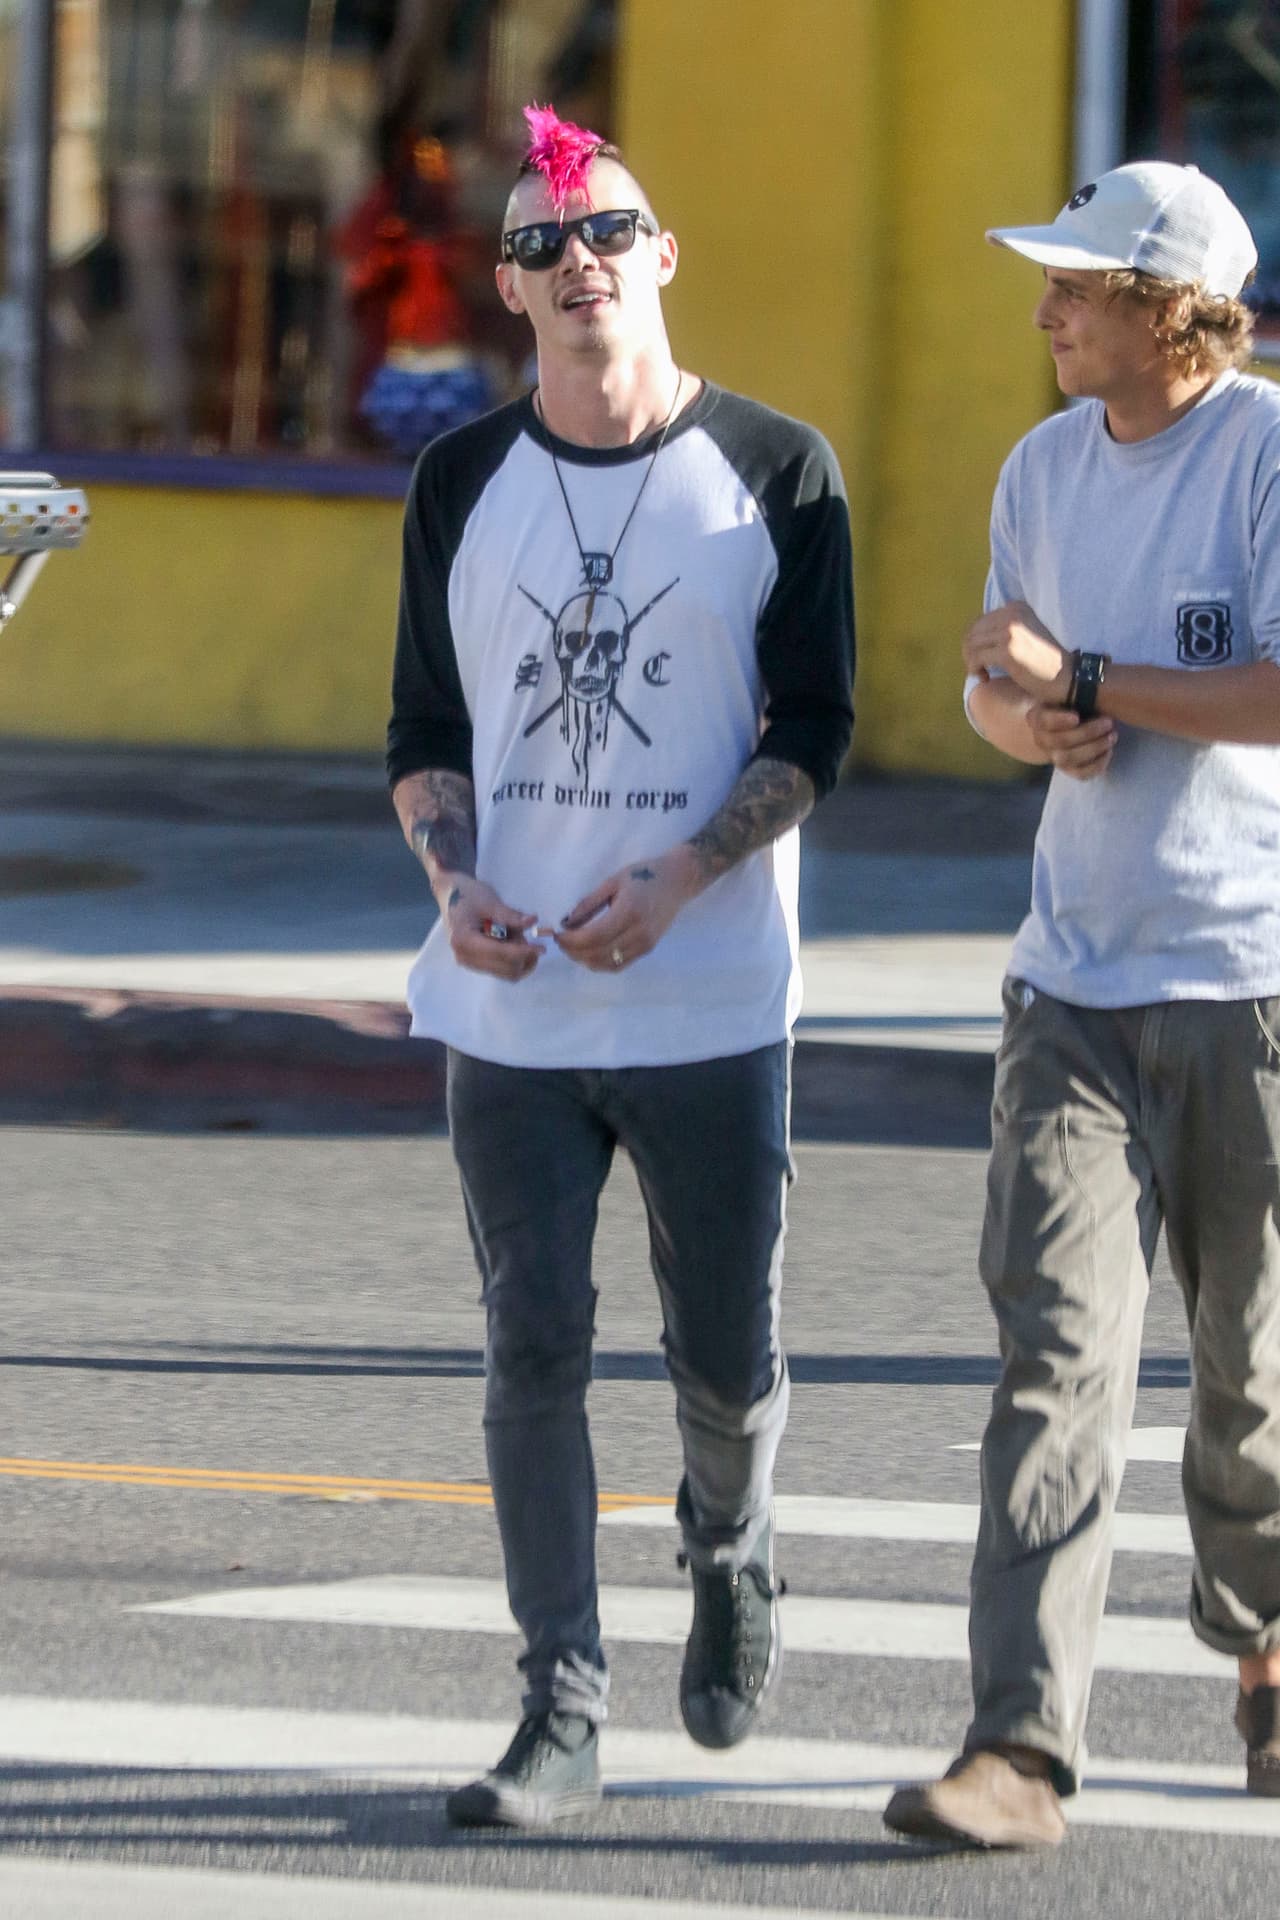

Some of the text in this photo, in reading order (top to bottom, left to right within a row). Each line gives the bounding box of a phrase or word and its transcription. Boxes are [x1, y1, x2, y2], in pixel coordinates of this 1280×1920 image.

[579, 552, 613, 586] D
[642, 651, 672, 687] C
[626, 790, 688, 814] corps
